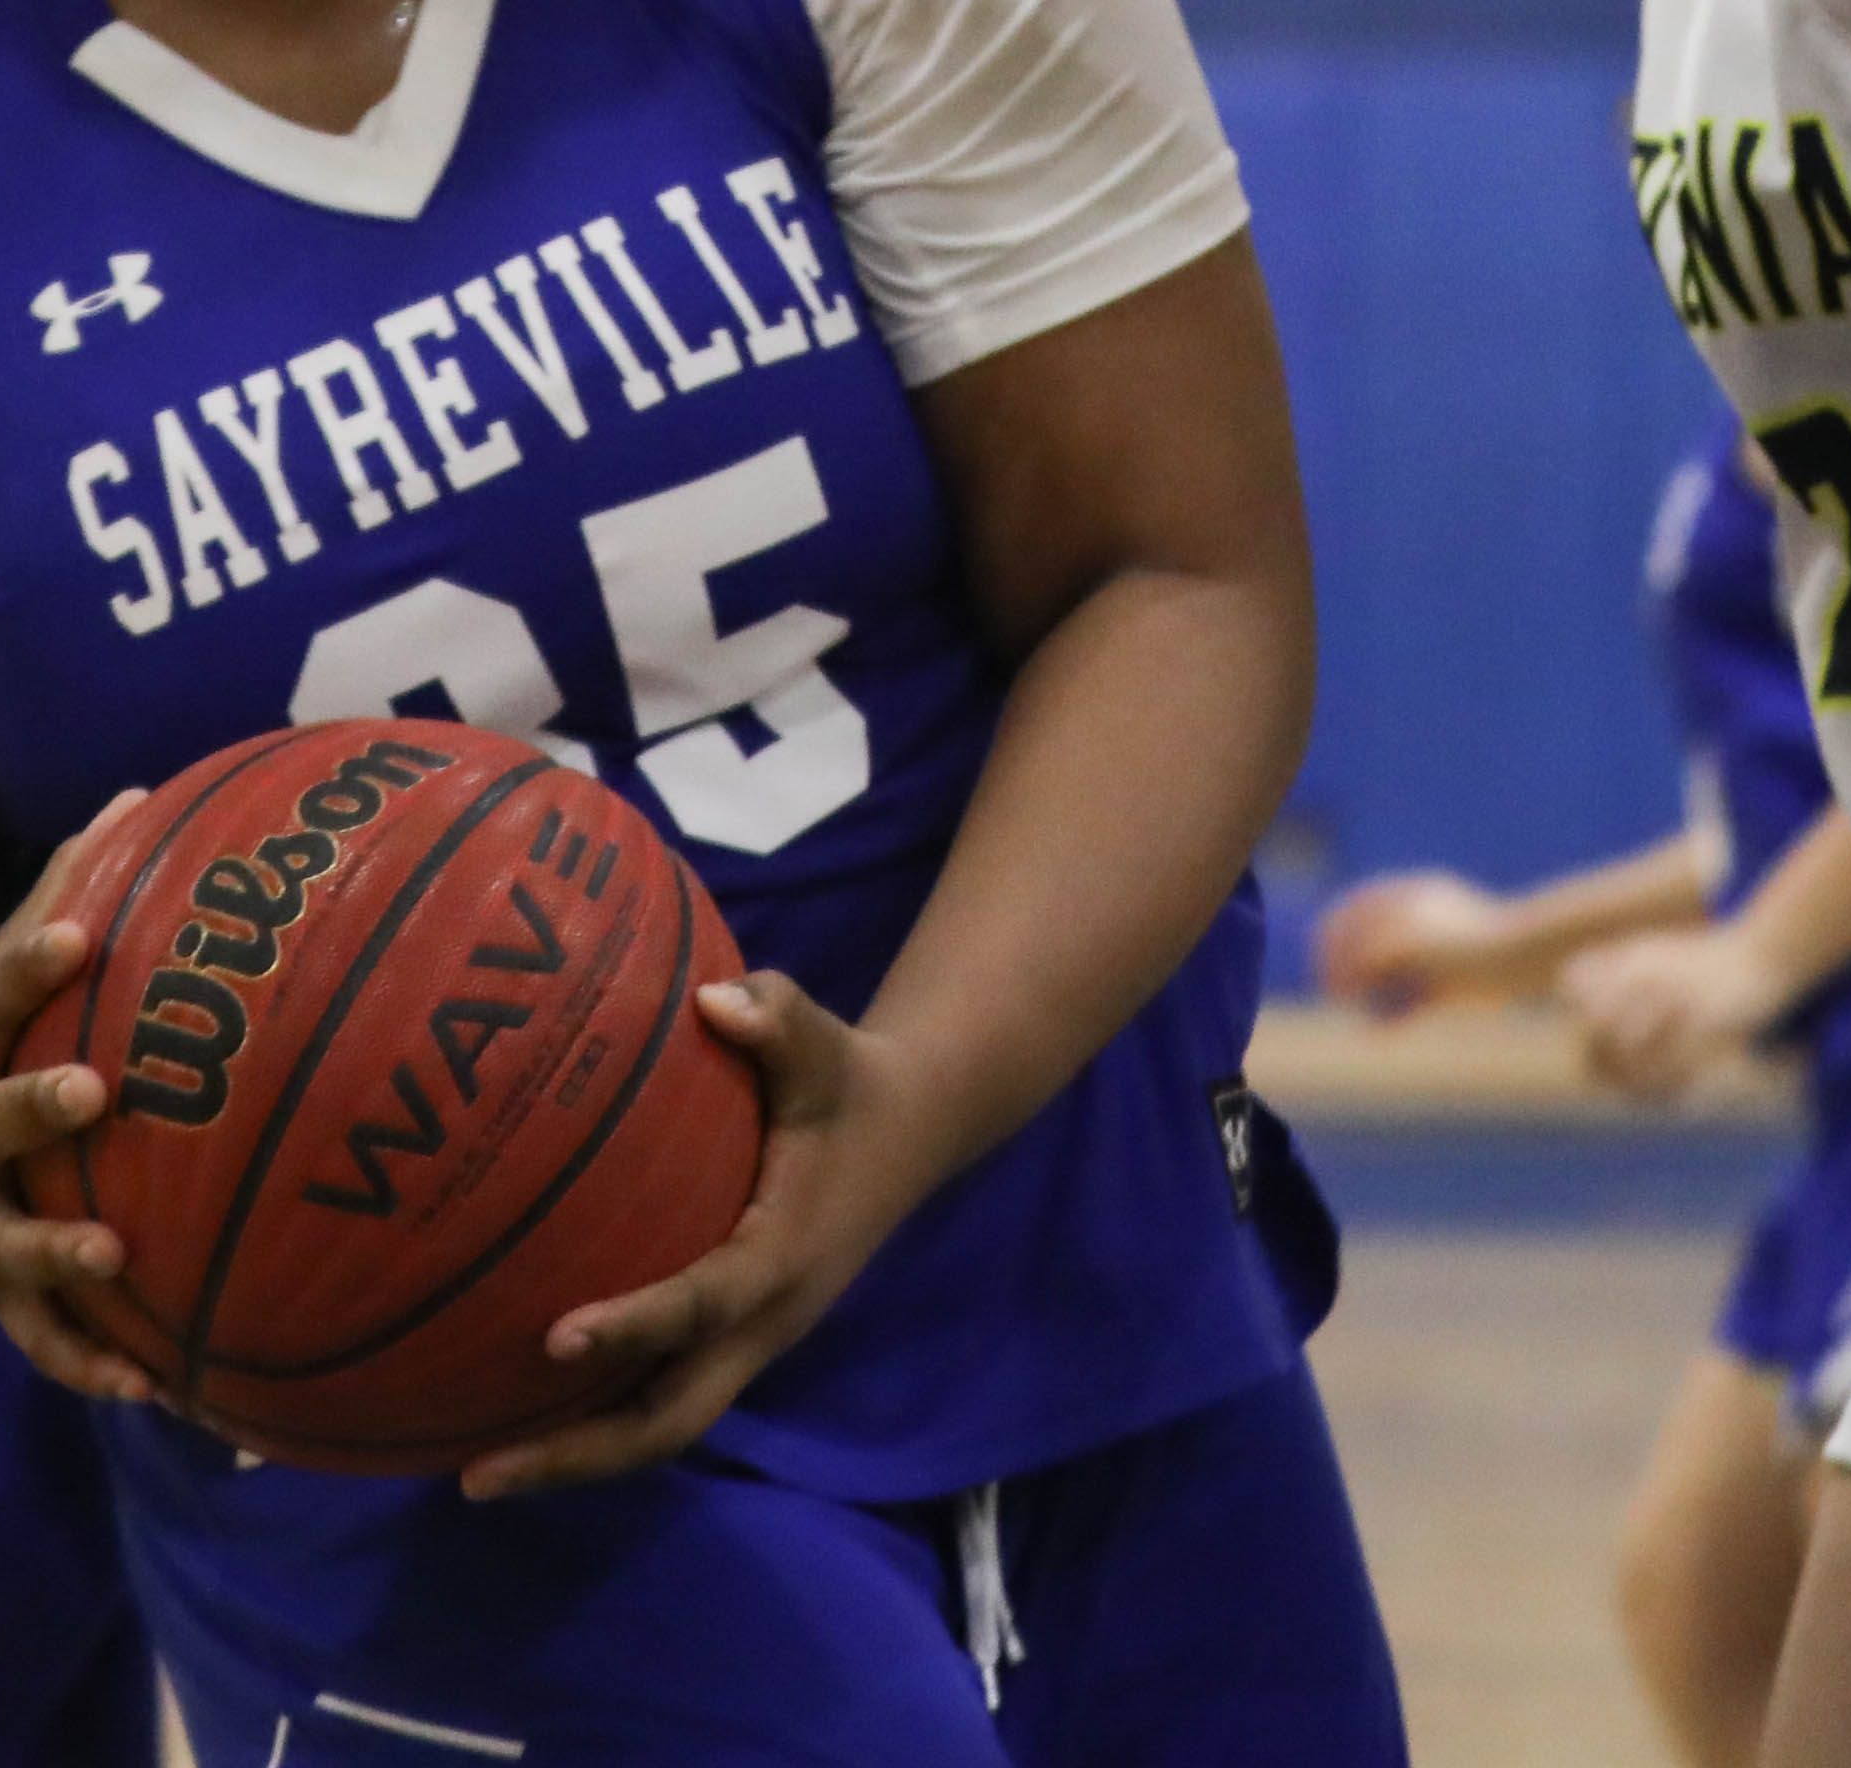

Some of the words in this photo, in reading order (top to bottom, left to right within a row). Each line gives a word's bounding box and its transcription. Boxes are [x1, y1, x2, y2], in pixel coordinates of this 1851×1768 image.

[66, 156, 859, 635] SAYREVILLE
[118, 739, 457, 1130] Wilson
[301, 808, 621, 1218] WAVE
